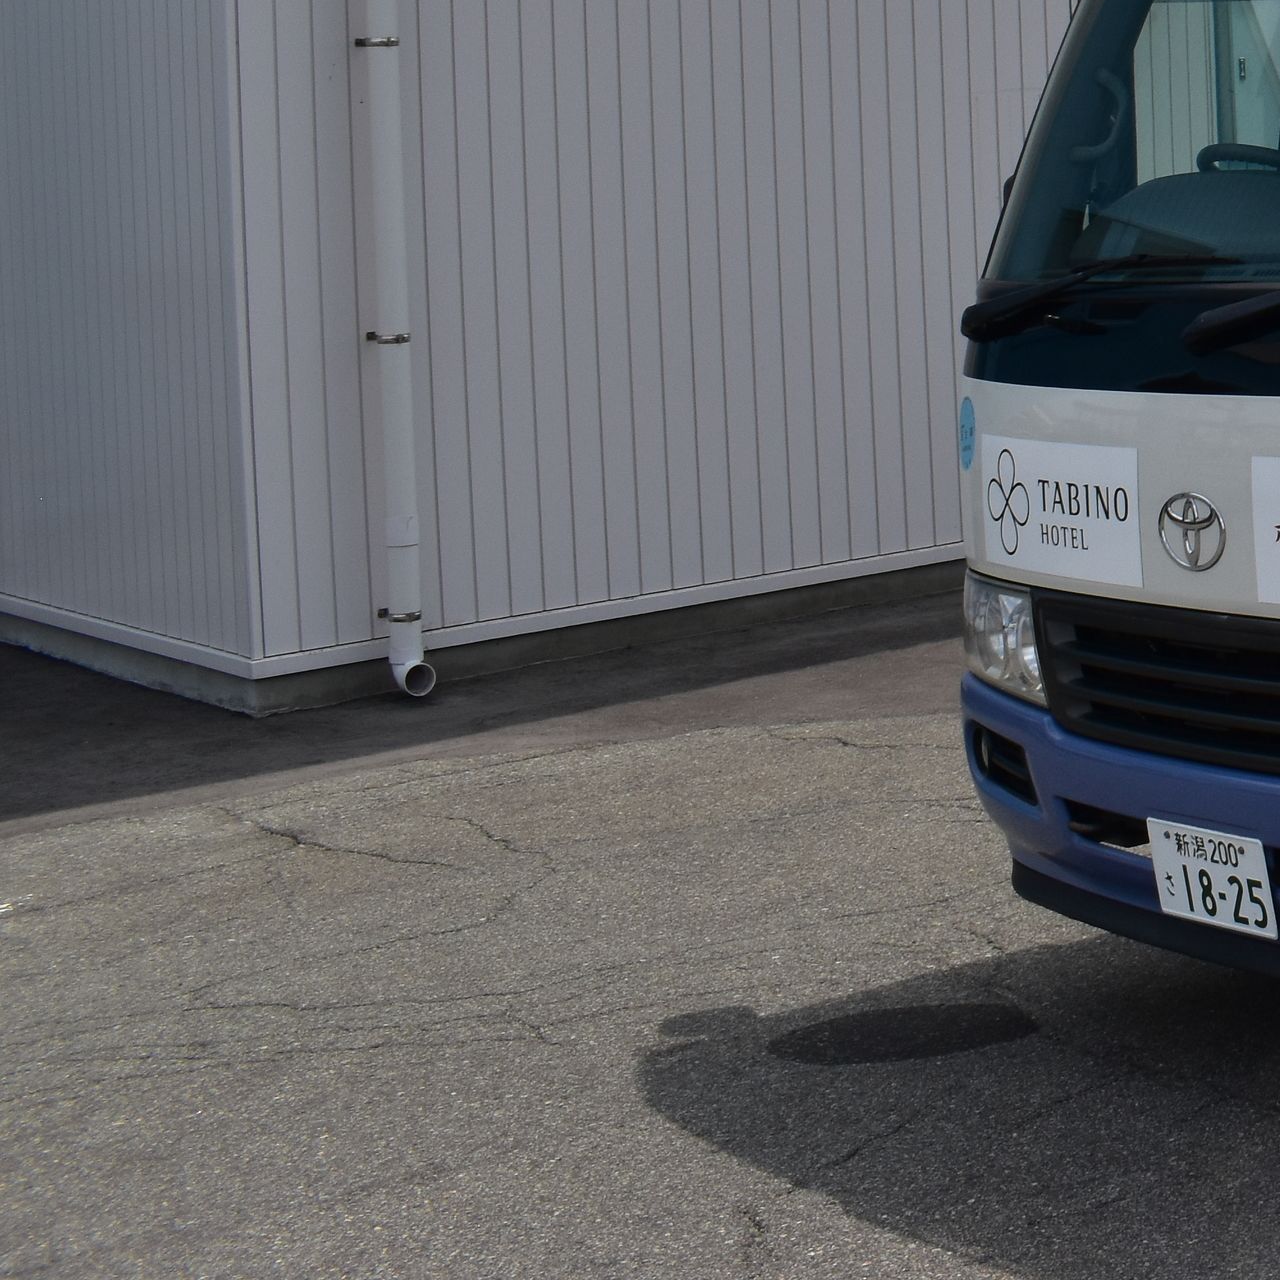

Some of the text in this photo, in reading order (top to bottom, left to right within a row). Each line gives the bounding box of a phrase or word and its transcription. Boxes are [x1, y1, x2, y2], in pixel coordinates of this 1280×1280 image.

[1037, 479, 1129, 522] TABINO
[1040, 523, 1089, 551] HOTEL
[1181, 864, 1269, 929] 18-25
